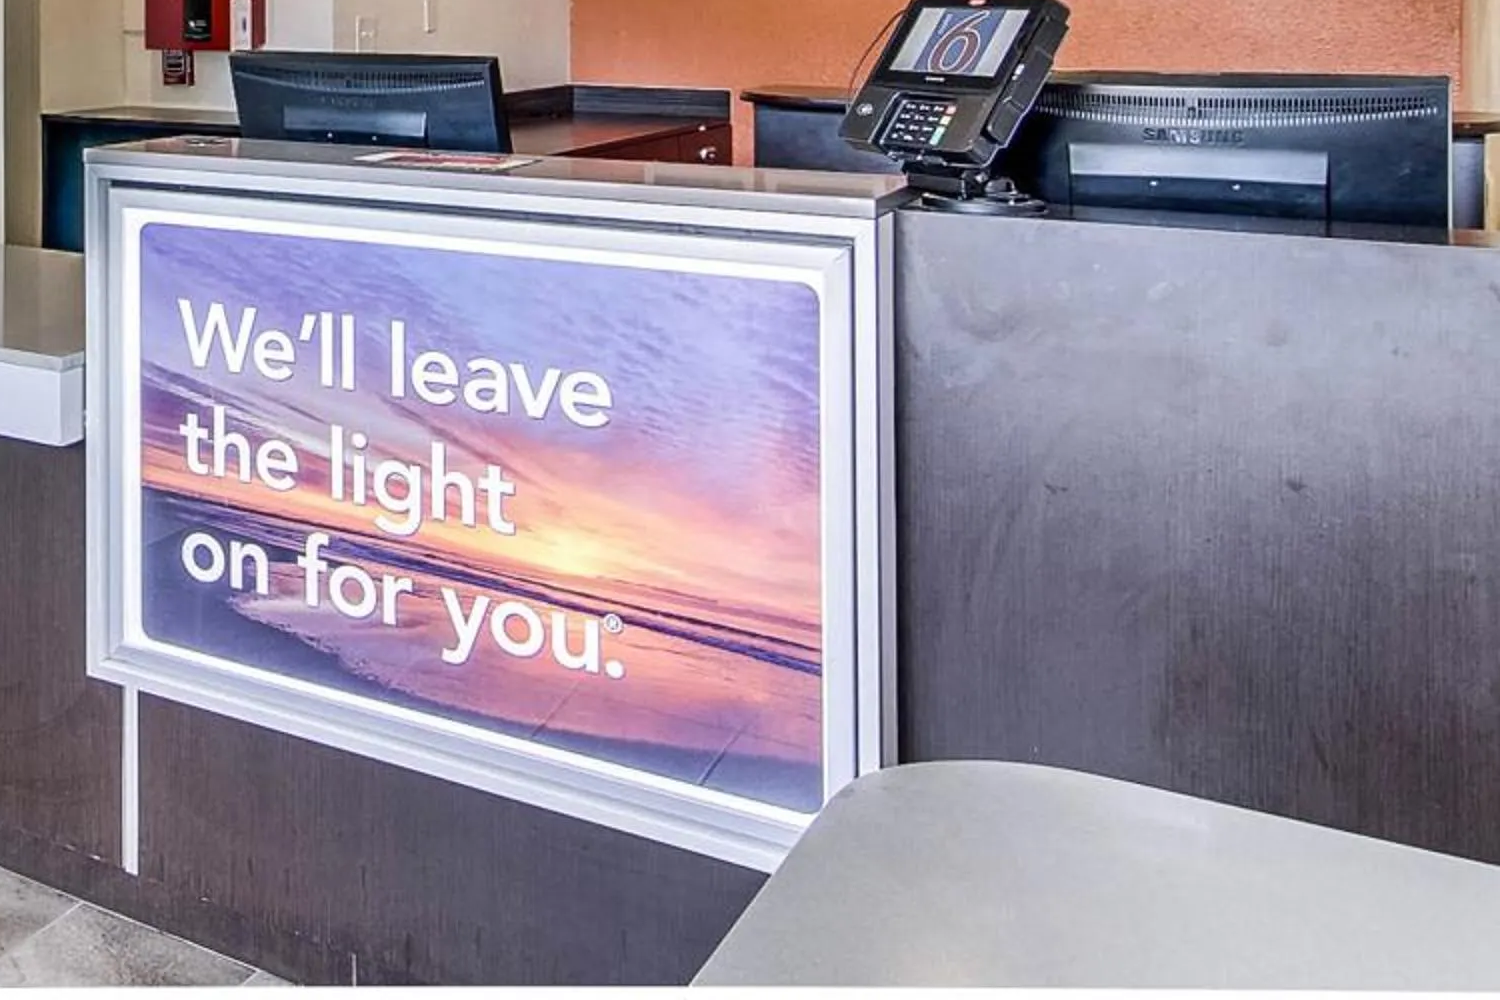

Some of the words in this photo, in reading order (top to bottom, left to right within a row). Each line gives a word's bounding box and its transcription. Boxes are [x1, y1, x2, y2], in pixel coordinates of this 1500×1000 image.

[928, 9, 990, 73] 6
[1142, 127, 1243, 144] SAMSUNG
[178, 298, 356, 391] We'll
[390, 319, 613, 428] leave
[180, 405, 298, 490] the
[329, 424, 517, 536] light
[180, 531, 270, 595] on
[297, 533, 414, 626] for
